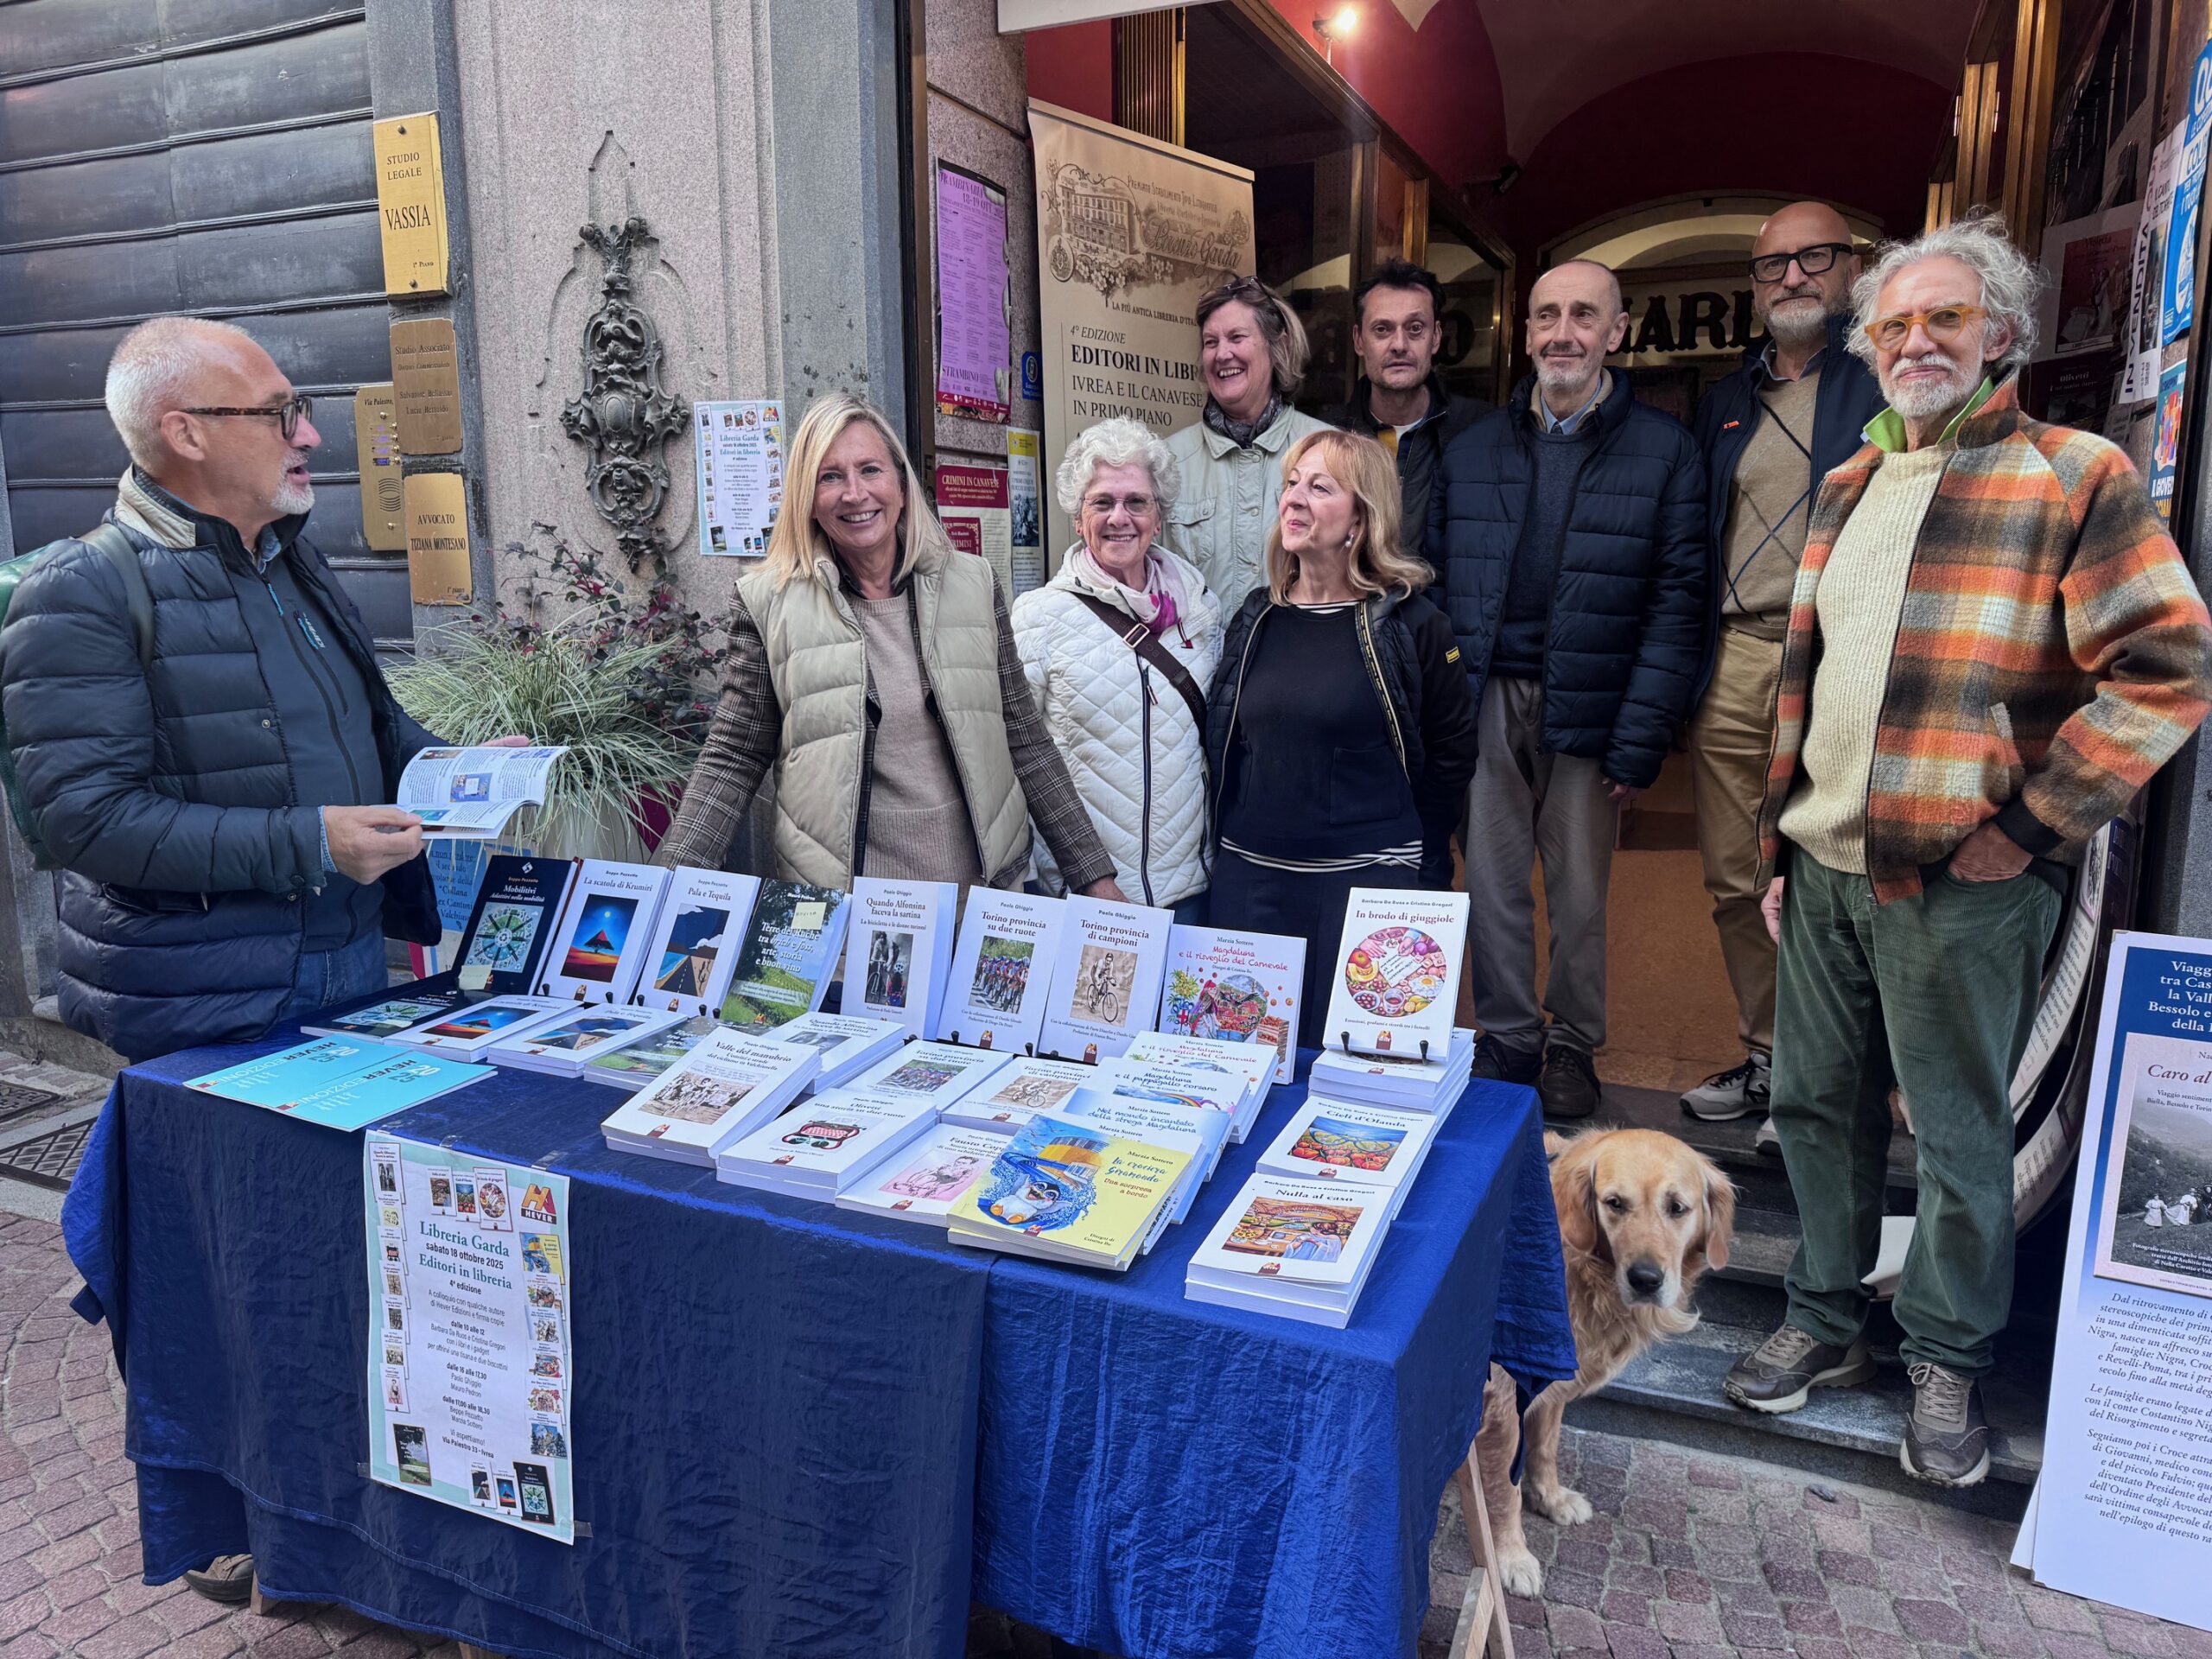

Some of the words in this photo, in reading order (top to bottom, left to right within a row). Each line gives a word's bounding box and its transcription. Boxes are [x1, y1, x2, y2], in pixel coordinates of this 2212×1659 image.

[387, 152, 420, 165] STUDIO
[388, 167, 422, 180] LEGALE
[385, 204, 431, 230] VASSIA
[2129, 223, 2149, 358] VENDITA
[1112, 302, 1120, 311] LA
[1121, 303, 1131, 312] PIÙ
[1132, 307, 1152, 318] ANTICA
[1154, 311, 1178, 323] LIBRERIA
[1081, 327, 1126, 344] EDIZIONE
[1071, 345, 1140, 373] EDITORI
[1145, 358, 1160, 375] IN
[942, 366, 978, 383] STRAMBINO
[2125, 363, 2134, 393] IN
[1072, 376, 1113, 395] IVREA
[1117, 382, 1124, 396] E
[1128, 383, 1139, 399] IL
[1142, 386, 1203, 408] CANAVESE
[1074, 400, 1087, 416] IN
[1091, 403, 1133, 420] PRIMO
[1136, 408, 1172, 427] PIANO
[942, 475, 965, 486] CRIMINI
[967, 476, 973, 485] IN
[973, 476, 999, 488] CANAVESE
[418, 514, 455, 525] AVVOCATO
[411, 538, 432, 551] TIZIANA
[434, 538, 466, 550] MONTESANO
[503, 885, 537, 894] Mobilitivi
[584, 878, 592, 886] La
[594, 879, 615, 888] scatola
[617, 880, 625, 889] di
[626, 881, 653, 892] Krumiri
[688, 887, 700, 896] Pala
[708, 889, 731, 901] Tequila
[866, 898, 894, 908] Quando
[896, 899, 926, 910] Alfonsina
[871, 907, 890, 917] faceva
[892, 909, 898, 917] la
[900, 910, 921, 919] sartina
[981, 911, 1008, 923] Torino
[1009, 915, 1046, 929] provincia
[1369, 911, 1396, 920] brodo
[1399, 912, 1408, 920] di
[1410, 913, 1454, 924] giuggiole
[998, 924, 1013, 933] due
[1014, 927, 1036, 937] ruote
[1080, 919, 1108, 931] Torino
[1110, 923, 1149, 939] provincia
[1088, 930, 1097, 939] di
[1098, 933, 1138, 947] campioni
[780, 951, 802, 961] storia
[1212, 946, 1255, 957] Magdaluna
[761, 957, 781, 969] buon
[783, 963, 801, 973] vino
[1196, 953, 1229, 964] risveglio
[1248, 959, 1289, 971] Carnevale
[2160, 975, 2181, 986] tra
[2168, 989, 2180, 1000] la
[2148, 1001, 2200, 1017] Bessolo
[2172, 1018, 2204, 1032] della
[283, 1041, 338, 1061] HEVER
[715, 1041, 735, 1054] Valle
[737, 1047, 751, 1055] del
[751, 1051, 792, 1062] manubrio
[220, 1058, 285, 1082] EDIZIONI
[2147, 1064, 2189, 1081] Caro
[2193, 1068, 2211, 1084] al
[1327, 1110, 1353, 1119] Cieli
[1355, 1116, 1406, 1127] d'Olanda
[1127, 1162, 1167, 1174] crociera
[1119, 1182, 1152, 1193] sorpresa
[1126, 1190, 1148, 1199] bordo
[1276, 1189, 1309, 1198] Nulla
[524, 1209, 553, 1223] HEVER
[420, 1220, 468, 1246] Libreria
[471, 1235, 510, 1257] Garda
[426, 1241, 450, 1256] sabato
[451, 1248, 458, 1258] 18
[459, 1249, 484, 1265] ottobre
[486, 1257, 504, 1270] 2025
[419, 1253, 456, 1275] Editori
[459, 1262, 470, 1278] in
[473, 1267, 512, 1290] libreria
[456, 1281, 482, 1295] edizione
[434, 1292, 458, 1305] colloquio
[467, 1299, 488, 1313] qualche
[489, 1306, 505, 1317] autore
[2112, 1293, 2130, 1303] Dal
[2132, 1298, 2195, 1317] ritrovamento
[2197, 1310, 2208, 1319] di
[2100, 1304, 2167, 1324] stereoscopiche
[2169, 1316, 2184, 1327] dei
[451, 1320, 463, 1329] dalle
[2095, 1314, 2106, 1323] in
[2108, 1318, 2126, 1328] una
[2128, 1321, 2185, 1340] dimenticata
[2087, 1325, 2117, 1339] Nigra,
[2120, 1332, 2146, 1344] nasce
[2148, 1338, 2160, 1347] un
[2162, 1341, 2199, 1355] affresco
[442, 1436, 450, 1445] Via
[451, 1438, 471, 1452] Palestro
[481, 1447, 494, 1459] Ivrea
[2087, 1428, 2133, 1447] Seguiamo
[2134, 1440, 2151, 1451] poi
[2152, 1442, 2157, 1451] i
[2159, 1445, 2188, 1459] Croce
[2099, 1509, 2154, 1529] nell'epilogo
[2156, 1523, 2166, 1532] di
[2168, 1525, 2199, 1541] questo
